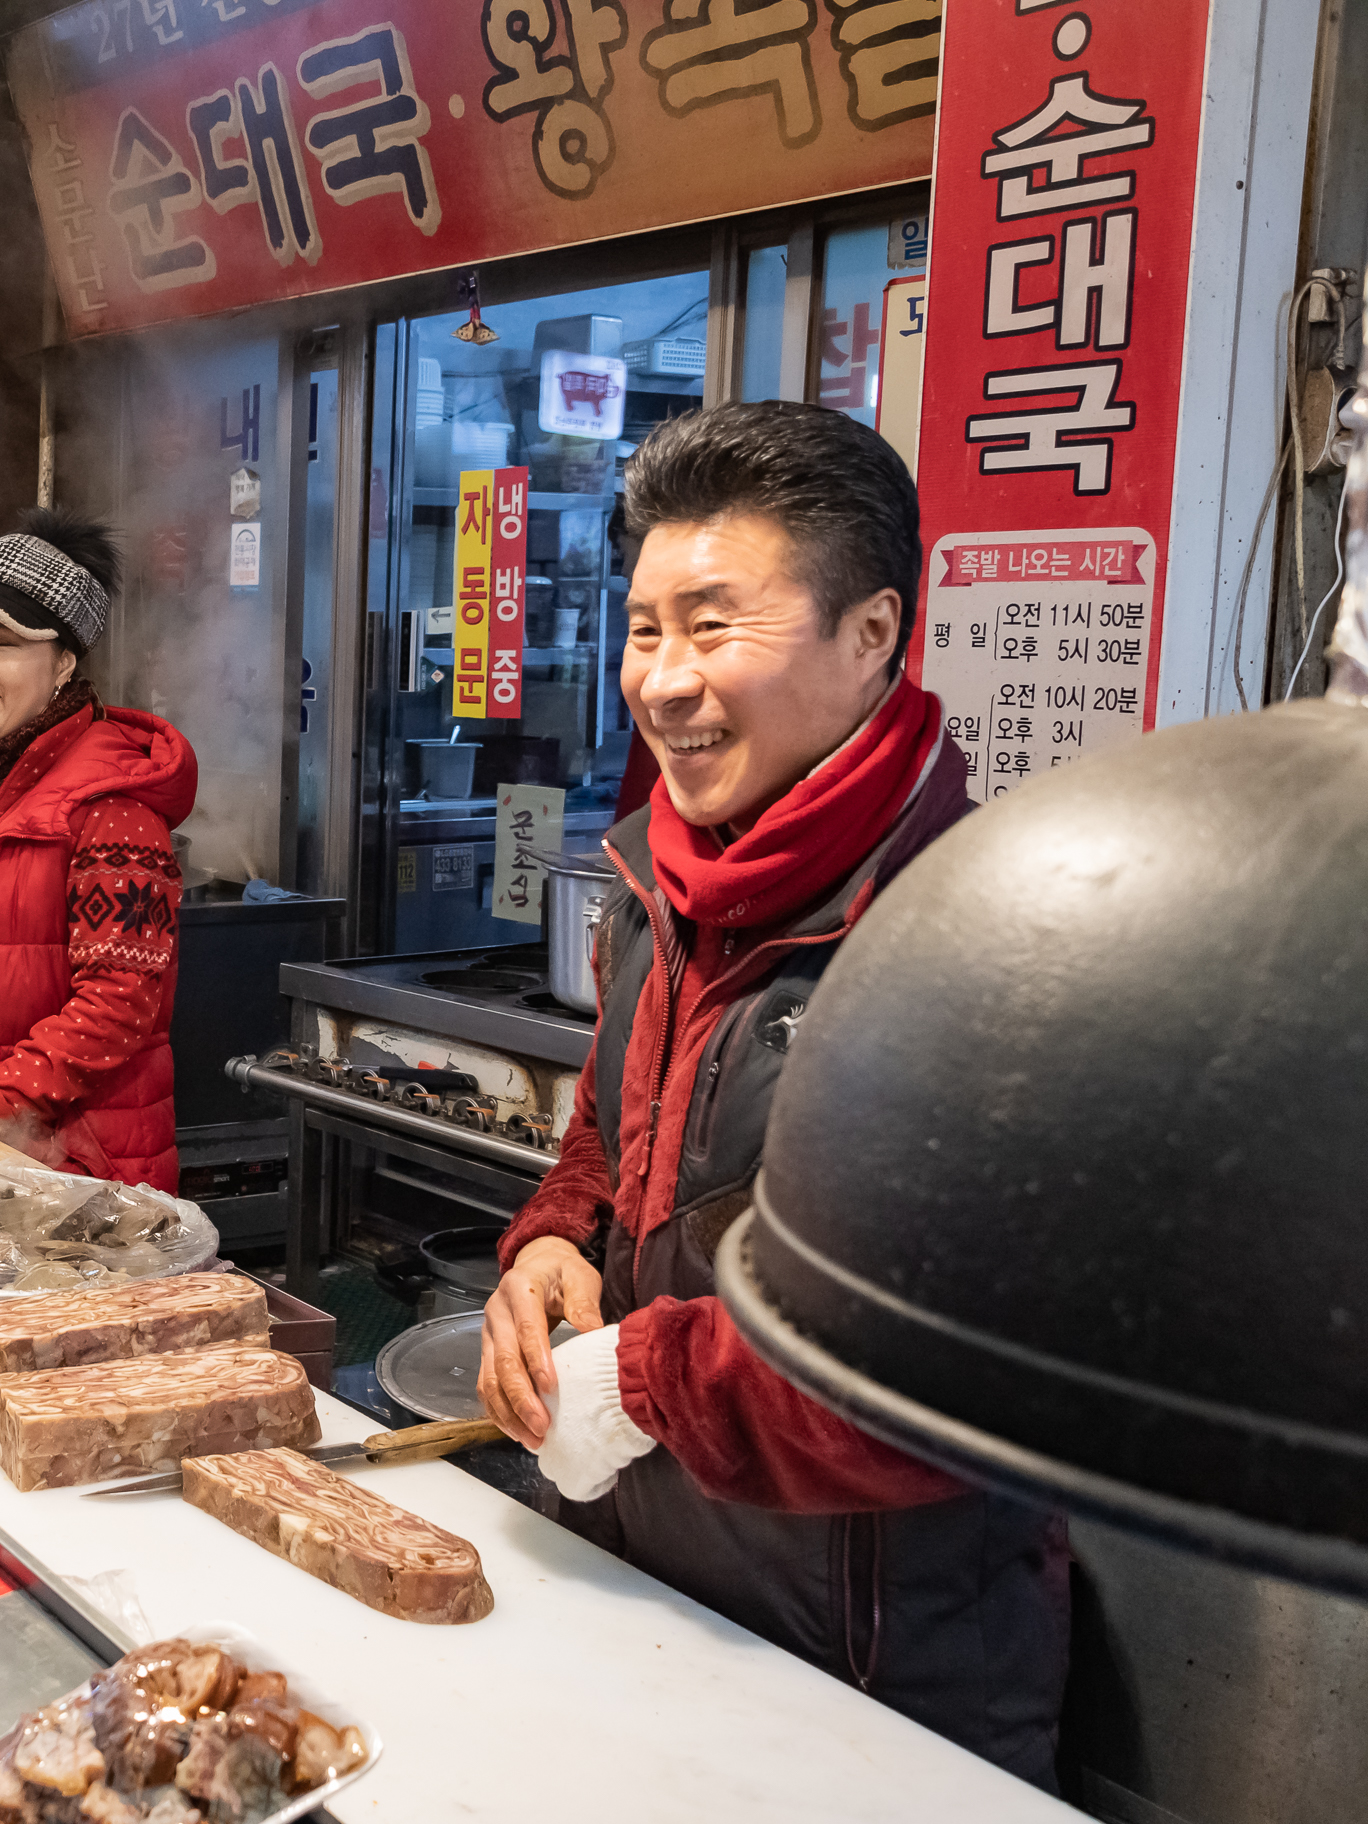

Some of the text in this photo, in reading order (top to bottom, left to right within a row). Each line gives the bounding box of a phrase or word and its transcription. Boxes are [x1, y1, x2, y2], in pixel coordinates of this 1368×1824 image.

[107, 0, 941, 296] 순대국 왕족
[964, 70, 1155, 497] 순대국
[959, 546, 1125, 578] 족발 나오는 시간
[457, 485, 491, 704] 자동문
[491, 483, 523, 704] 냉방중
[1002, 602, 1145, 629] 오전 11시 50분
[1000, 636, 1142, 666] 오후 5시 30분
[997, 683, 1138, 714] 오전 10시 20분
[946, 716, 981, 742] 요일
[995, 717, 1083, 747] 오후 3시
[993, 751, 1031, 778] 오후
